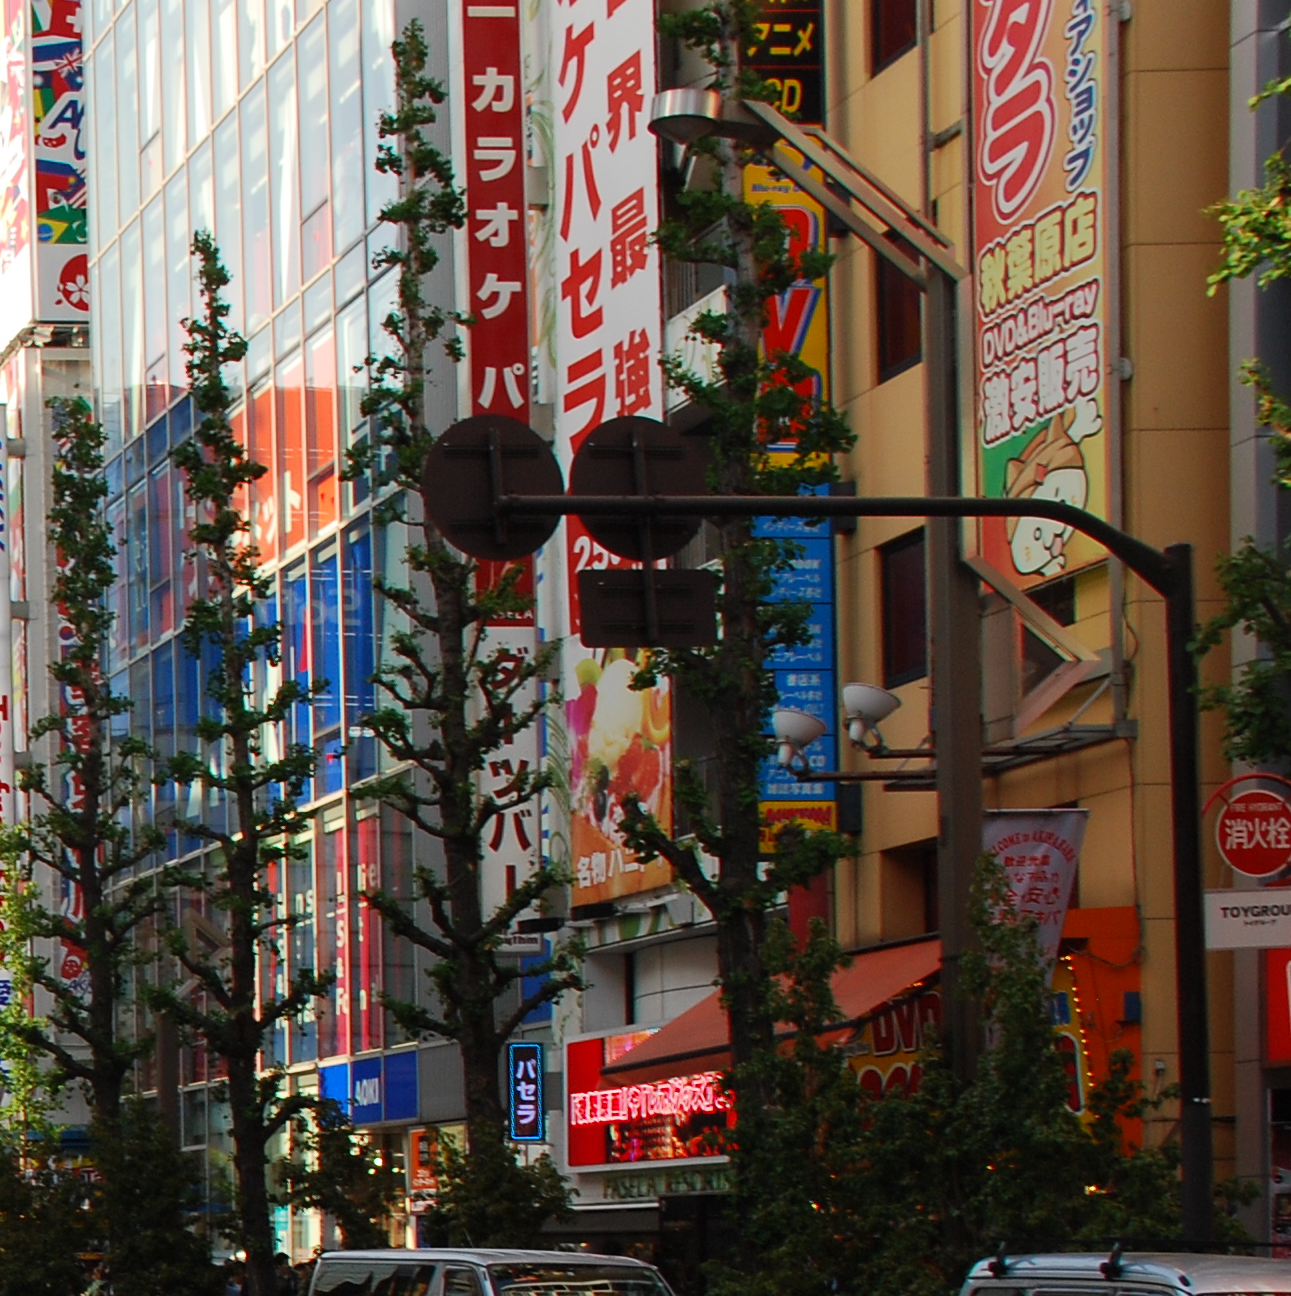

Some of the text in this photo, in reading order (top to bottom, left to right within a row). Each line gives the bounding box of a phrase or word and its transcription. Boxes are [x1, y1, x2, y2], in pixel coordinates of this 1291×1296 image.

[558, 0, 606, 455] ケパセラ
[606, 0, 651, 416] 界最強
[979, 195, 1097, 316] 秋葉原店
[982, 280, 1098, 364] DVD&Blu-ray
[982, 324, 1098, 444] 激安販売
[1224, 817, 1291, 850] 消火栓
[355, 1078, 379, 1106] AOKI
[516, 1059, 536, 1124] パセラ
